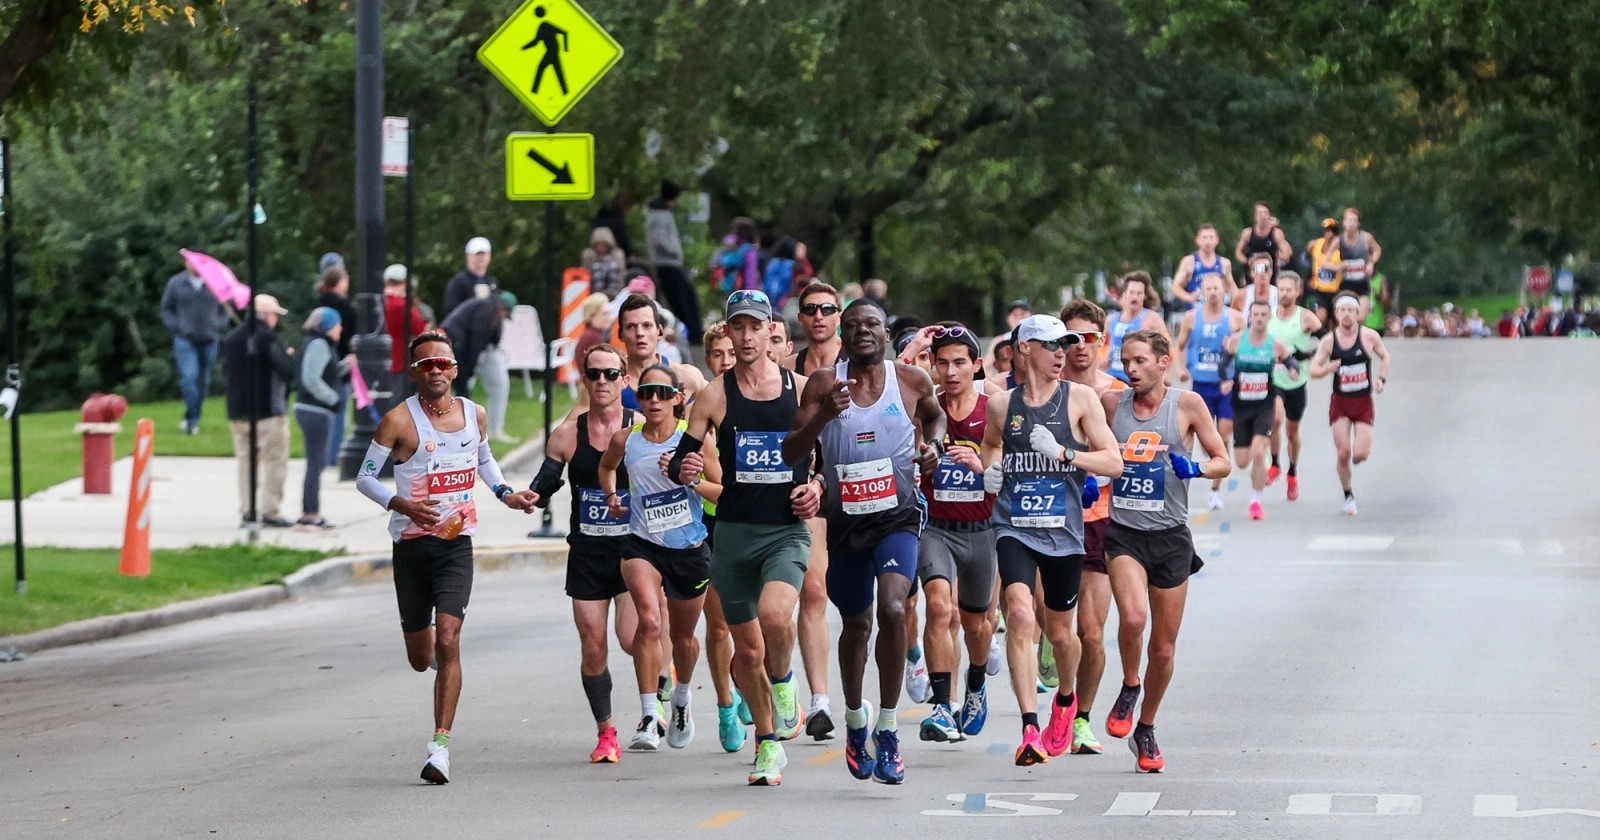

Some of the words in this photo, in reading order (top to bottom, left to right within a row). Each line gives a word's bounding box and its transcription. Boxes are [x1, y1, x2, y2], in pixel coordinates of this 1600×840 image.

[745, 449, 783, 466] 843
[430, 476, 441, 488] A
[443, 470, 475, 487] 25017
[940, 469, 976, 486] 794
[1120, 476, 1155, 494] 758
[841, 484, 851, 496] A
[852, 478, 893, 496] 21087
[1020, 494, 1055, 511] 627
[588, 505, 618, 520] 87
[646, 502, 688, 521] LINDEN
